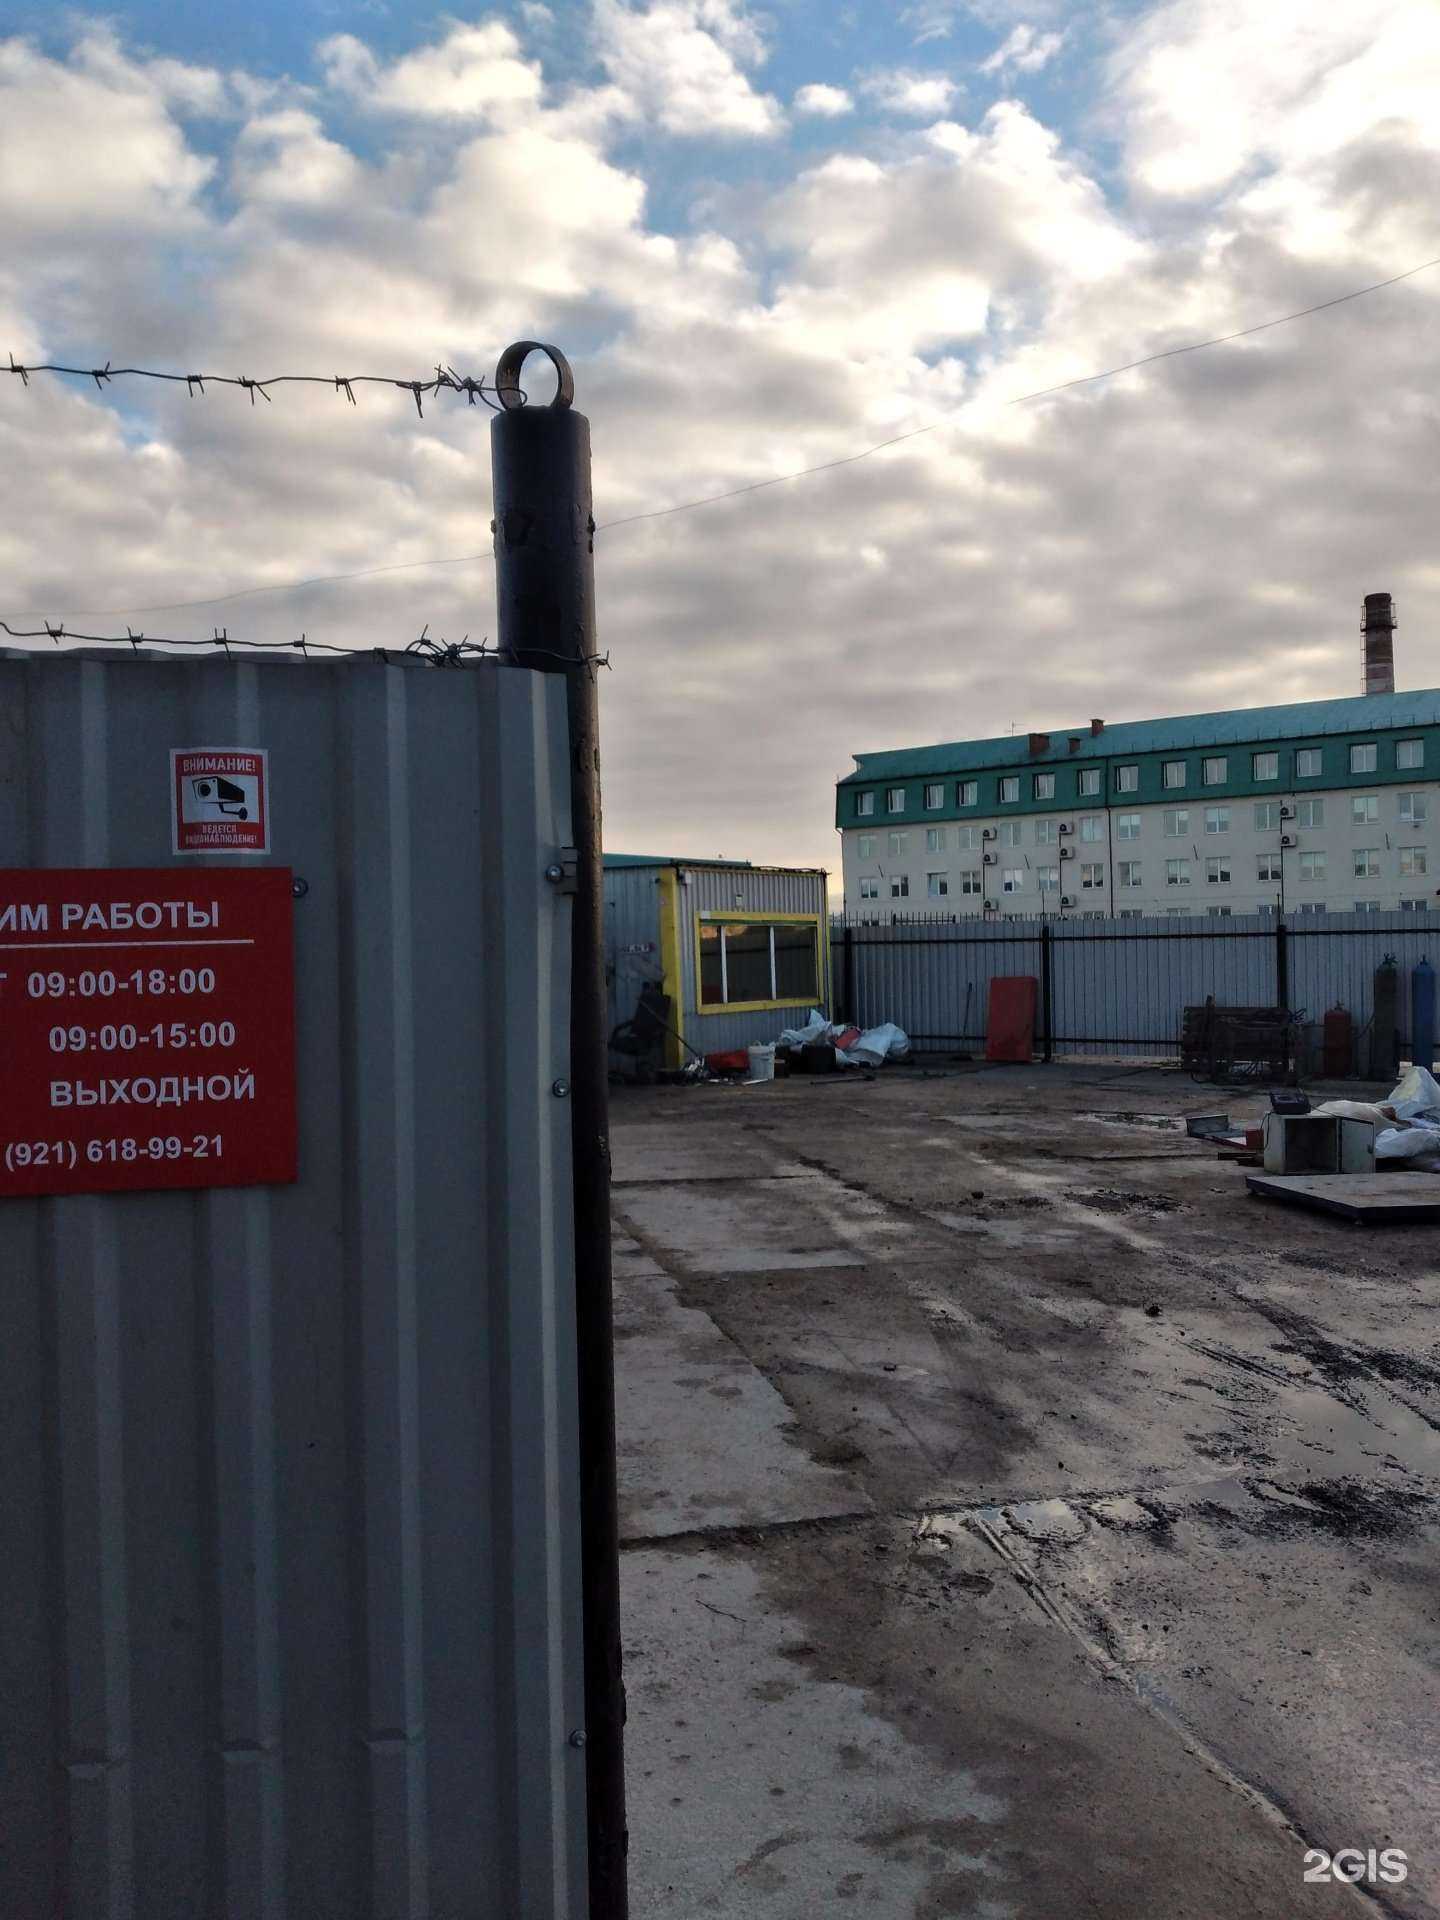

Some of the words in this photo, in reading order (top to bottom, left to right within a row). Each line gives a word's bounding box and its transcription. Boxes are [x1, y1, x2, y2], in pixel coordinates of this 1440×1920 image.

[183, 757, 256, 772] ВНИМАНИЕ!
[202, 824, 237, 833] ВЕДЕТСЯ
[62, 901, 219, 930] РАБОТЫ
[28, 968, 216, 997] 09:00-18:00
[49, 1021, 236, 1052] 09:00-15:00
[50, 1068, 255, 1107] ВЫХОДНОЙ
[5, 1141, 77, 1172] (921)
[87, 1135, 223, 1162] 618-99-21
